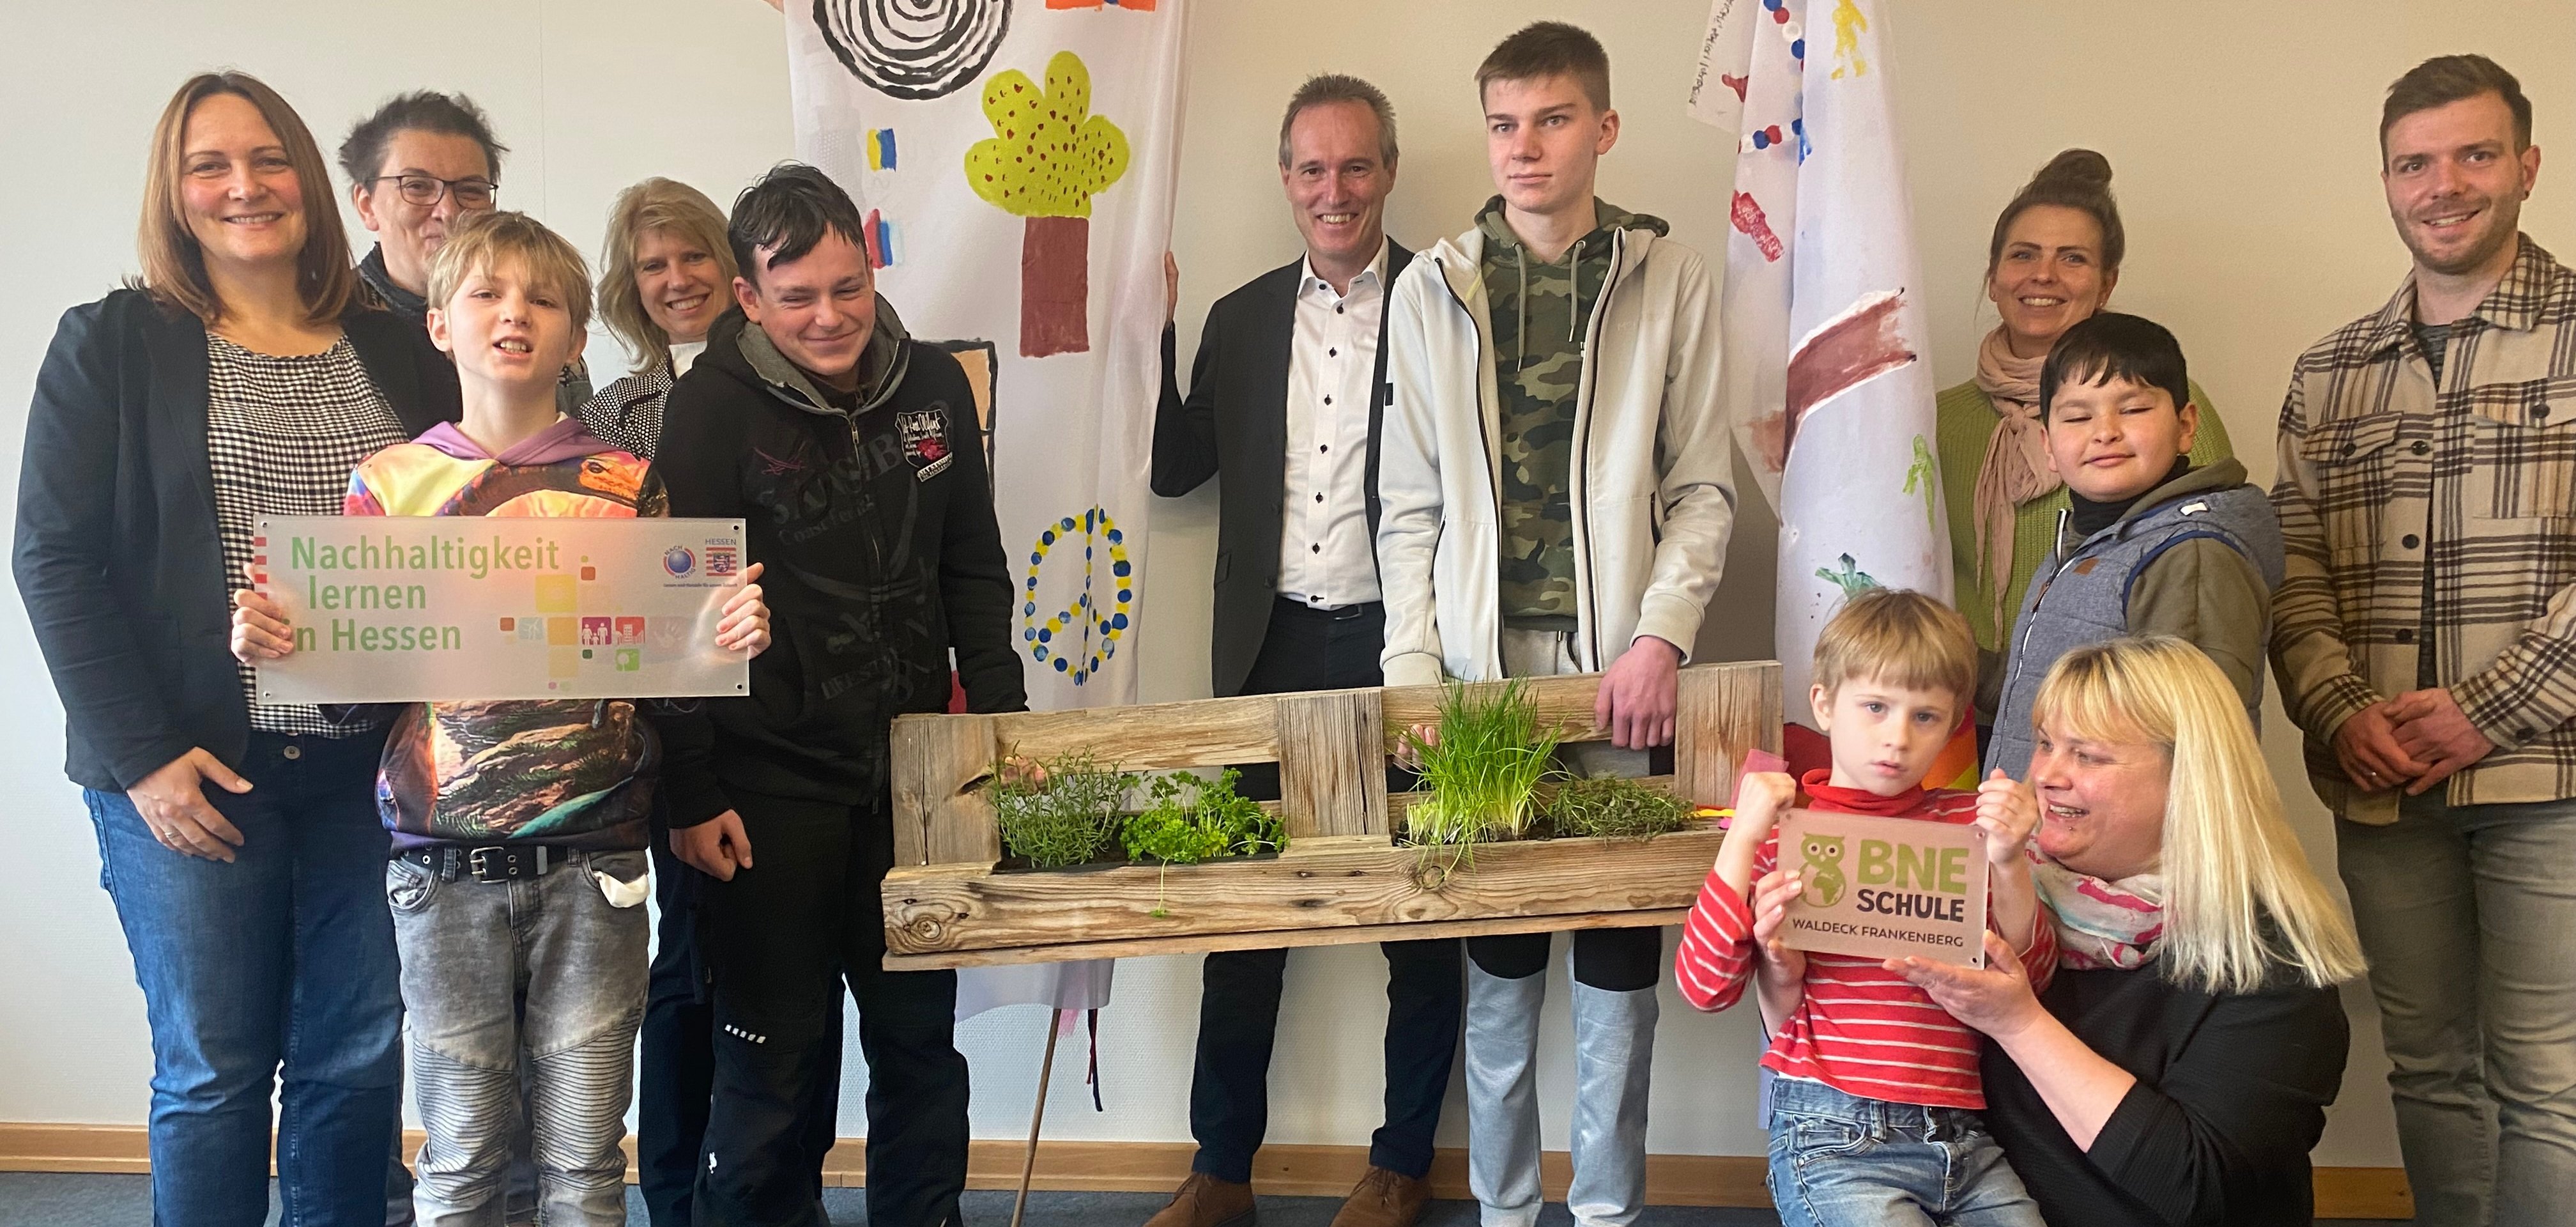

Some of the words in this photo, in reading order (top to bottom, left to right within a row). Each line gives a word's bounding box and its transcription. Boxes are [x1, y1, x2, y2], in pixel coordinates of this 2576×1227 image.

[291, 536, 559, 579] Nachhaltigkeit
[664, 545, 683, 555] NACH
[309, 576, 426, 610] lernen
[282, 618, 316, 651] n
[332, 618, 461, 651] Hessen
[1857, 839, 1969, 895] BNE
[1857, 889, 1965, 922] SCHULE
[1793, 918, 1857, 936] WALDECK
[1862, 927, 1963, 946] FRANKENBERG
